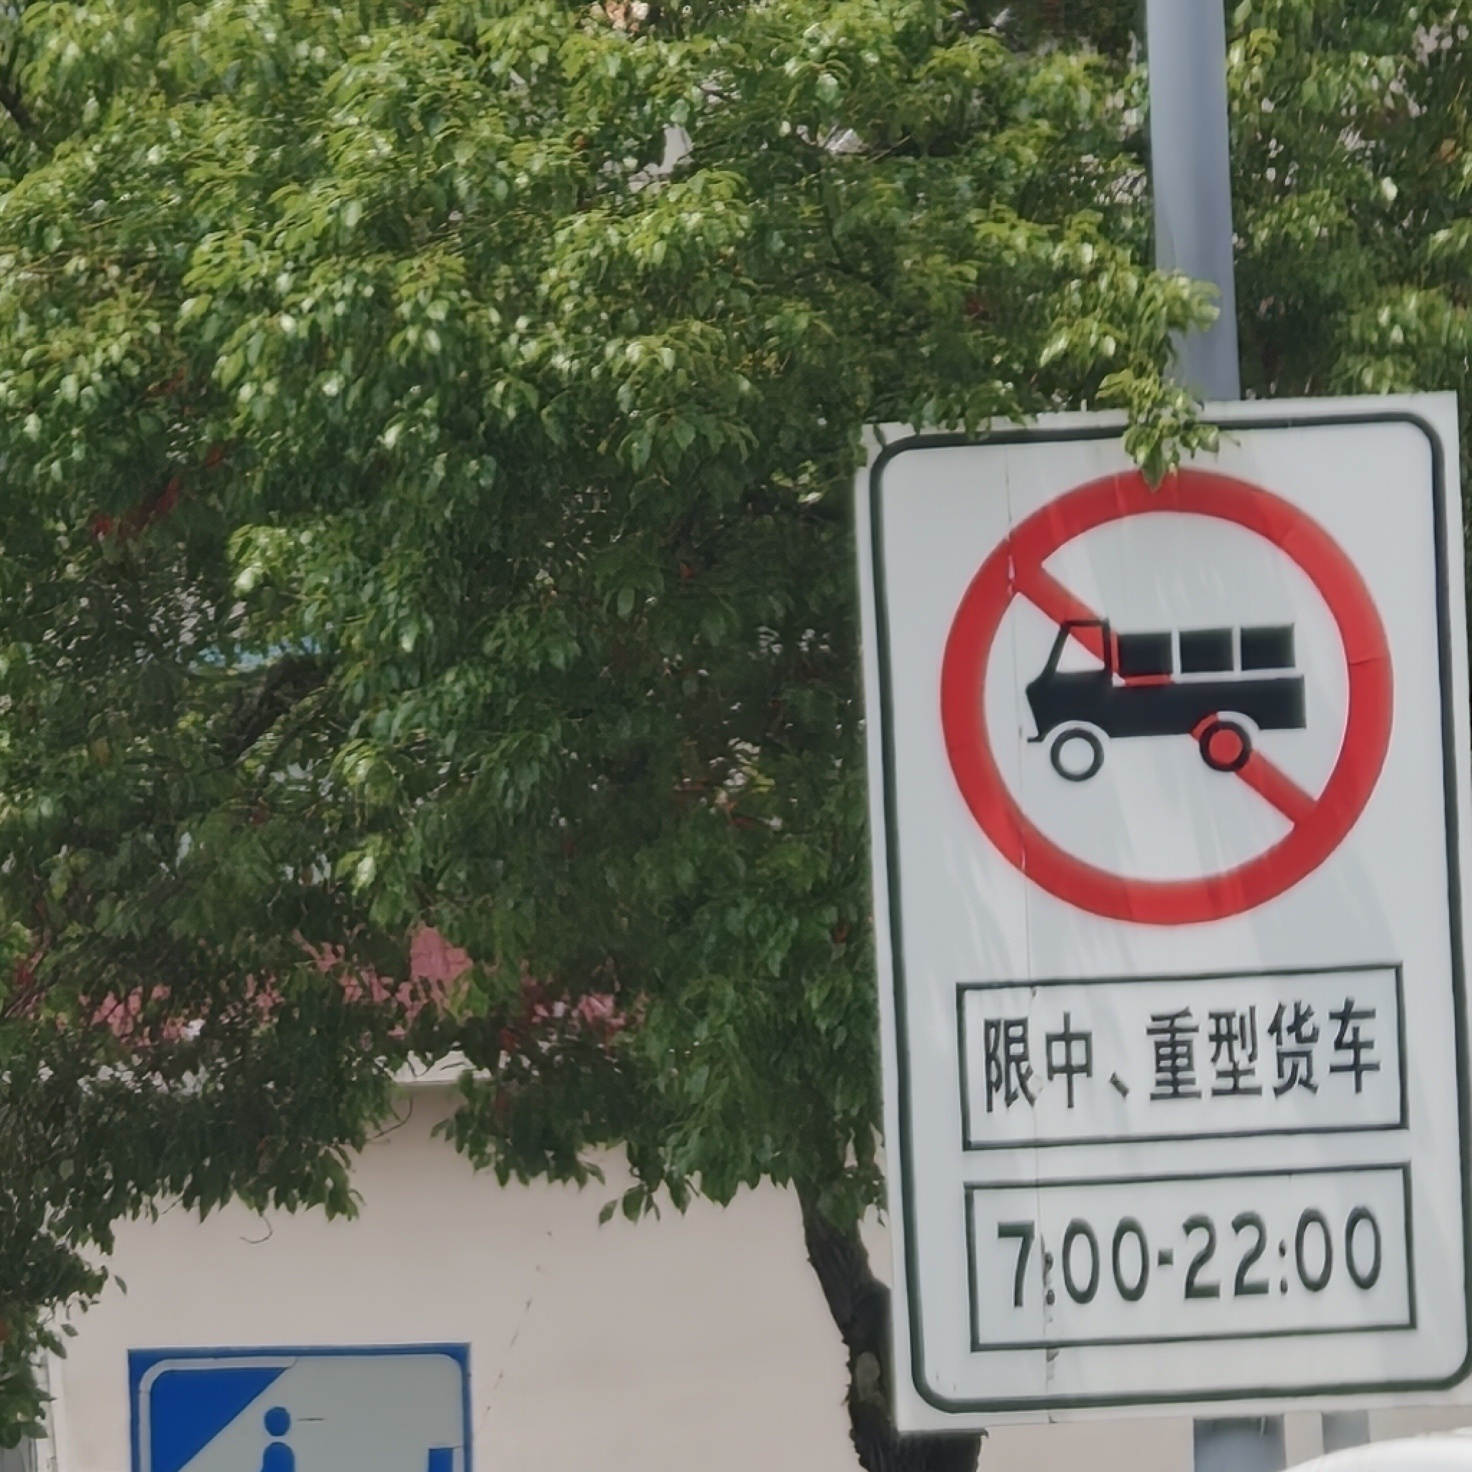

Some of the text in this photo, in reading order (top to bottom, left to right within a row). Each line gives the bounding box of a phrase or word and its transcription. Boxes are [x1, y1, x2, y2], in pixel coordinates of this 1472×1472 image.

[984, 996, 1381, 1112] 限中、重型货车
[997, 1206, 1382, 1308] 7:00-22:00
